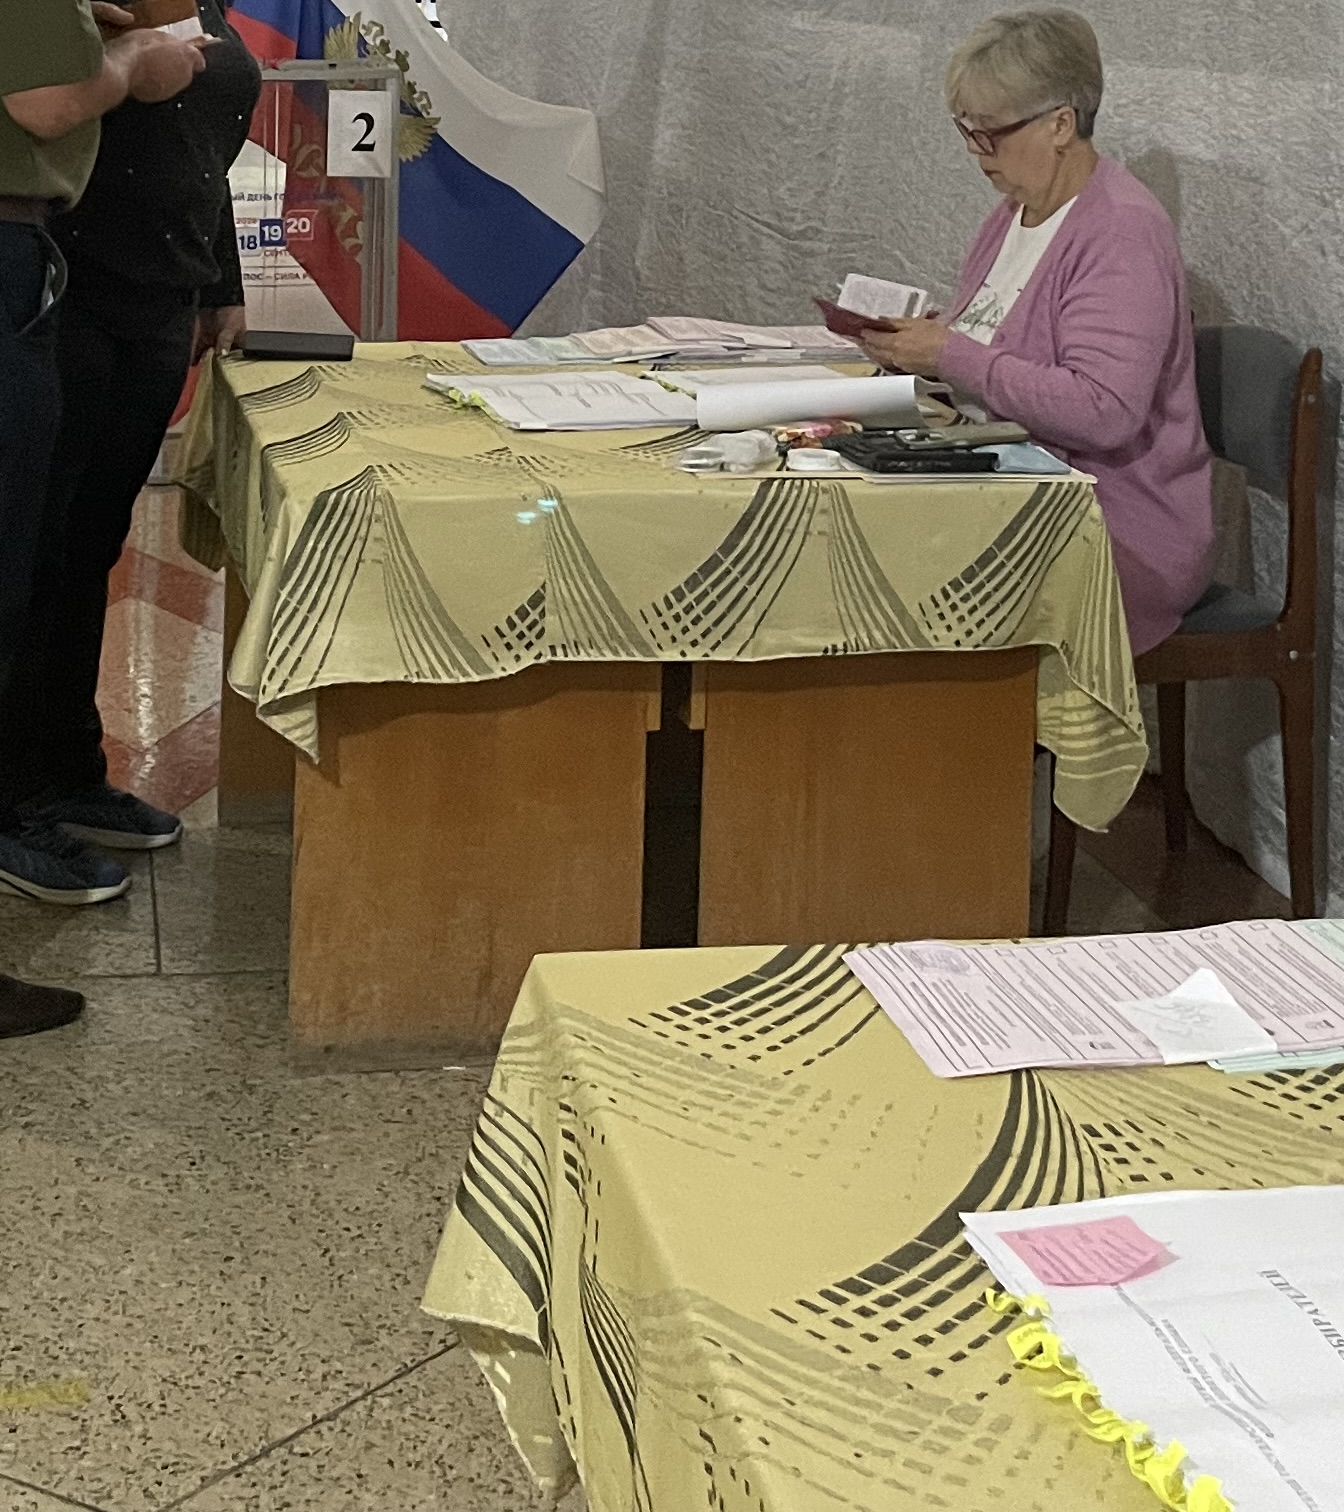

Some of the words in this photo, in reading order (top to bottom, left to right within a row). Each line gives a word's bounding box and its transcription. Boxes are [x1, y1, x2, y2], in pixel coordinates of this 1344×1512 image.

[351, 112, 376, 152] 2
[247, 193, 272, 201] ДЕНЬ
[239, 235, 258, 250] 18
[261, 225, 282, 241] 19
[286, 217, 311, 233] 20
